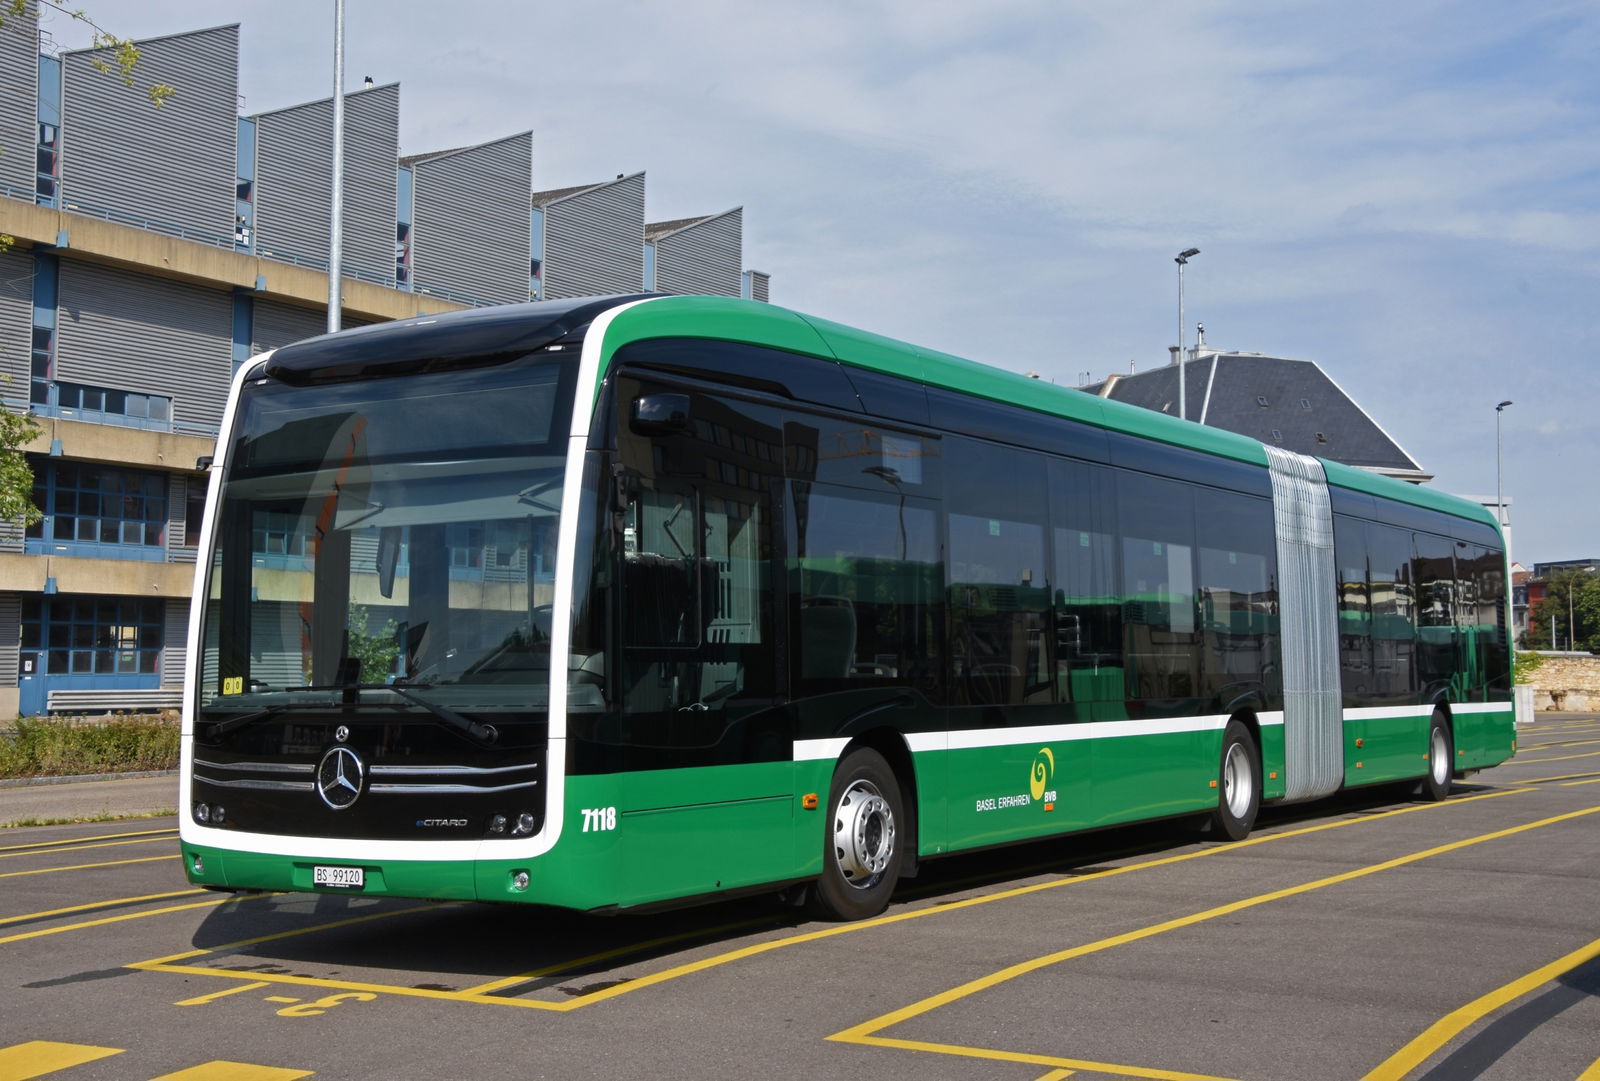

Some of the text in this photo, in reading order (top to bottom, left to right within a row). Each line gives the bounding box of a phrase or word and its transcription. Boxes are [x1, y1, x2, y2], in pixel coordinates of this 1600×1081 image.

[976, 794, 1031, 812] BASEL ERFAHREN
[1044, 791, 1057, 802] BVB
[581, 806, 616, 832] 7118
